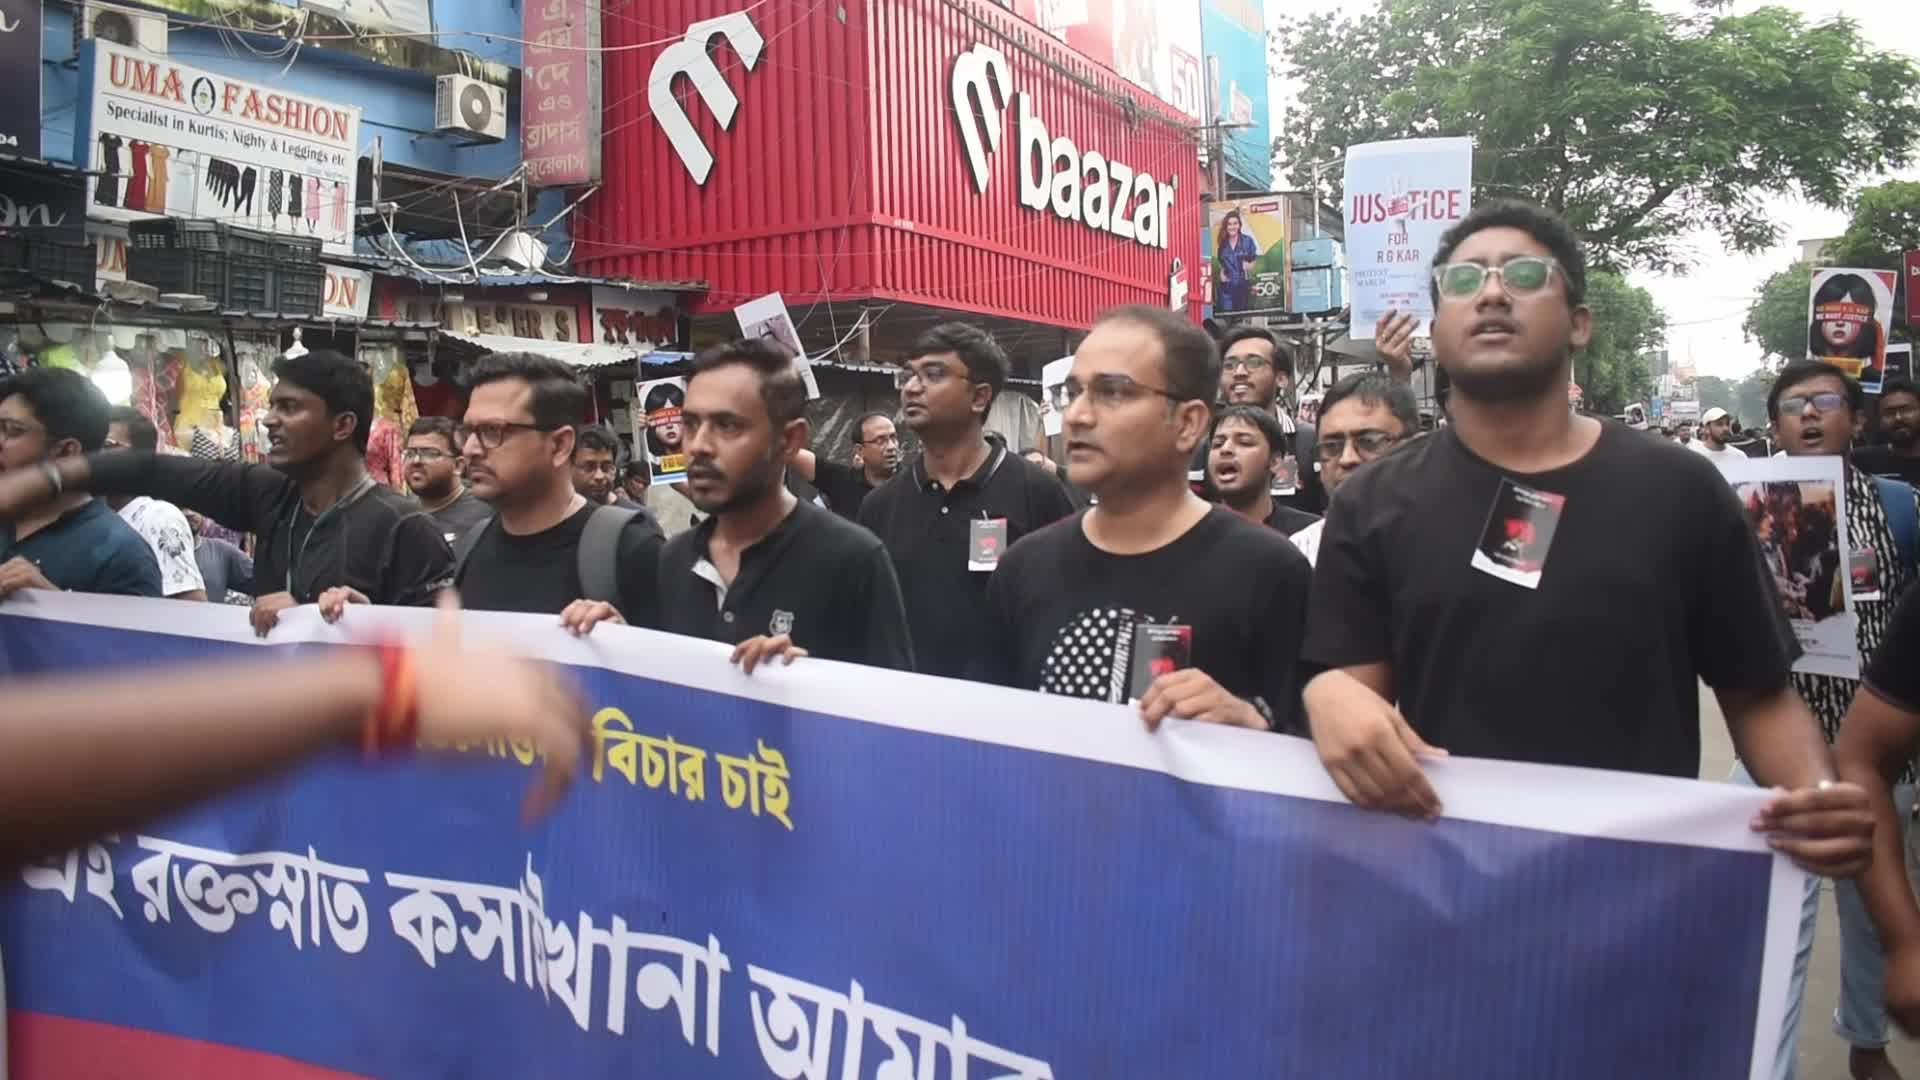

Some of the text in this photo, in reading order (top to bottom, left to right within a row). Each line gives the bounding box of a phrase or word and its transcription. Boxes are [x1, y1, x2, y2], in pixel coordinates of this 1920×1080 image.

[106, 100, 168, 129] Specialist
[173, 112, 184, 131] in
[233, 129, 267, 154] Nighty
[270, 136, 278, 150] &
[282, 140, 329, 165] Leggings
[109, 52, 351, 141] UMA FASHION
[1018, 91, 1174, 249] baazar
[1350, 190, 1462, 224] JUSTICE
[1377, 251, 1385, 263] R
[1397, 249, 1420, 262] KAR
[1388, 233, 1408, 245] FOR
[591, 707, 793, 830] বিচার চাই
[131, 835, 370, 953] রক্তস্নাত
